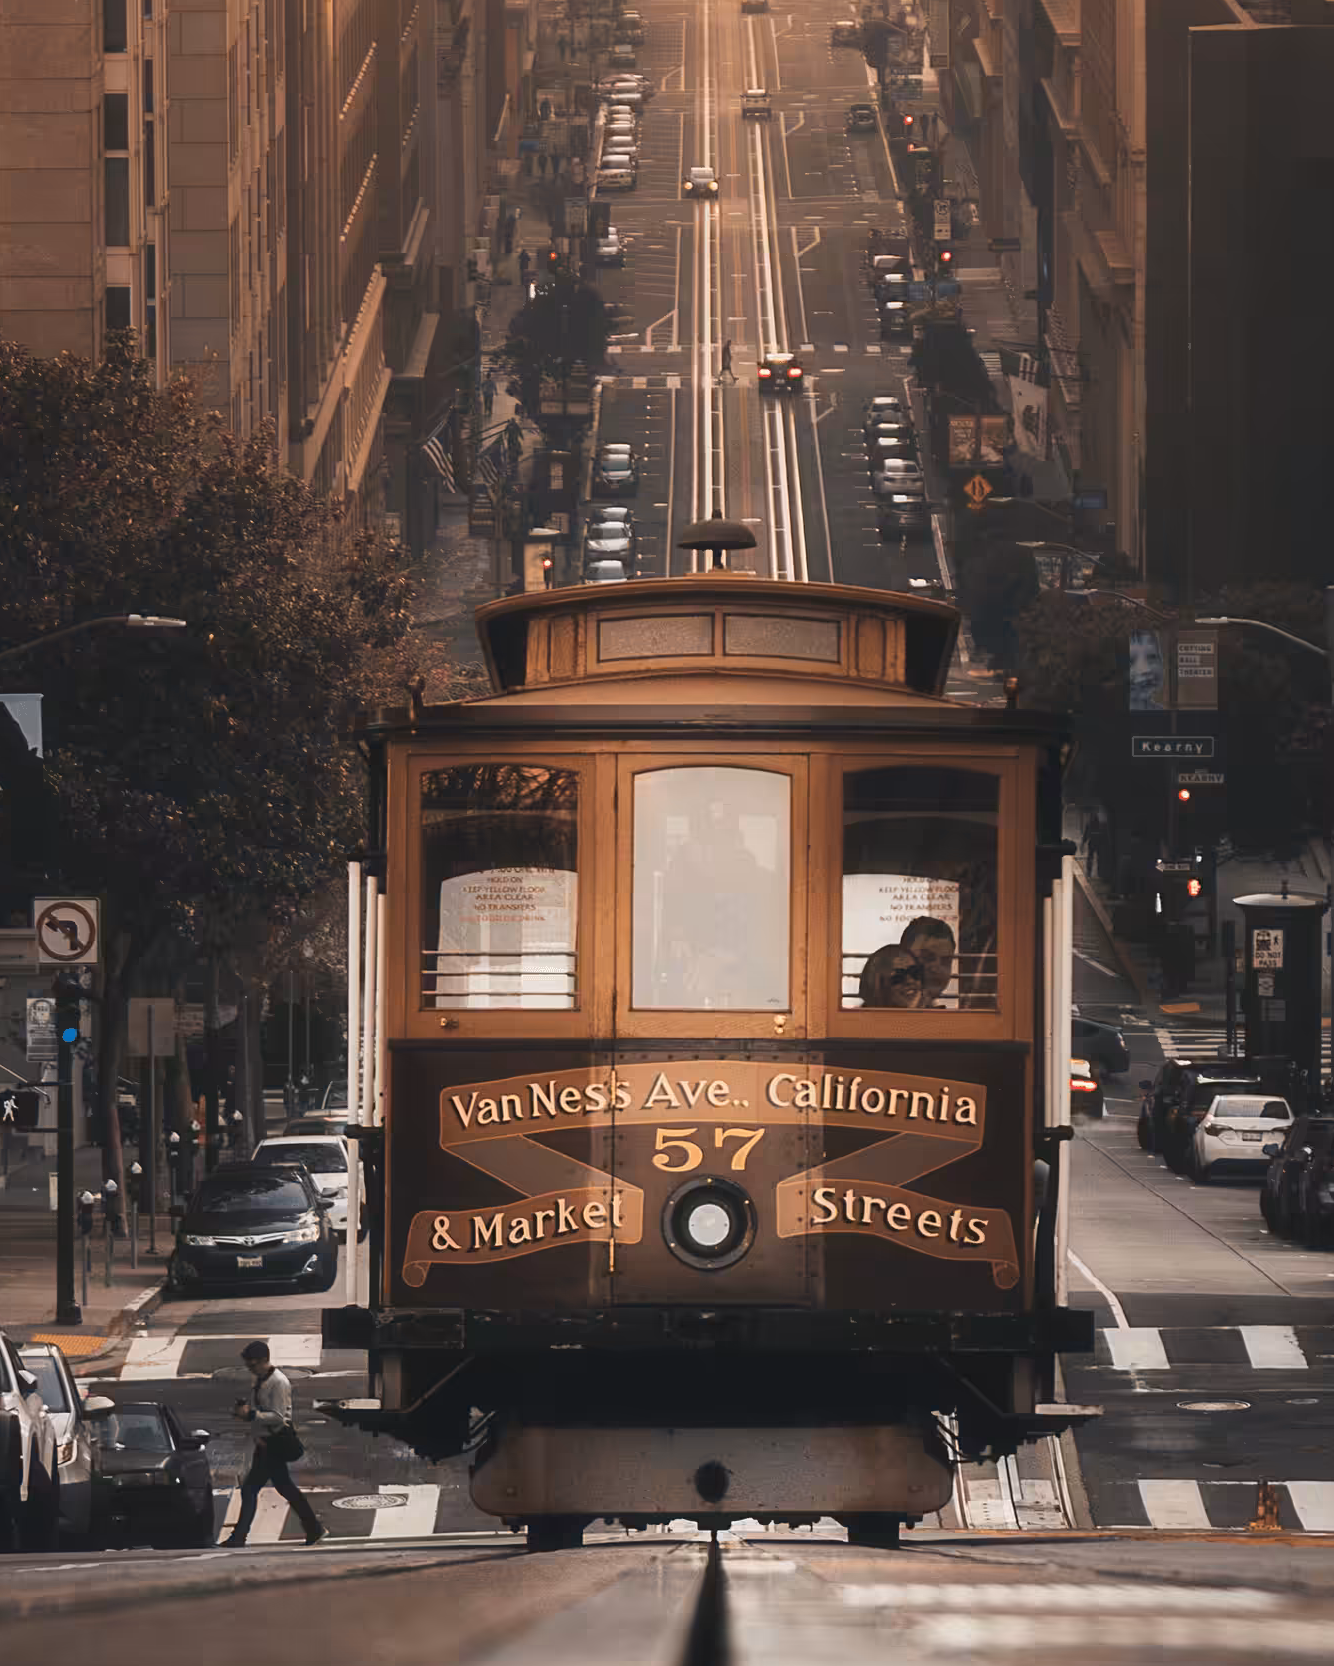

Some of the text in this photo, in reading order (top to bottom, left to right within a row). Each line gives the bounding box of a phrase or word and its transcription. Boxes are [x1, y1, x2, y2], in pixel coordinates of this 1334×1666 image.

[1142, 741, 1204, 755] Kearny
[766, 1073, 978, 1125] California
[651, 1127, 766, 1173] 57
[431, 1187, 989, 1250] & Market Streets
